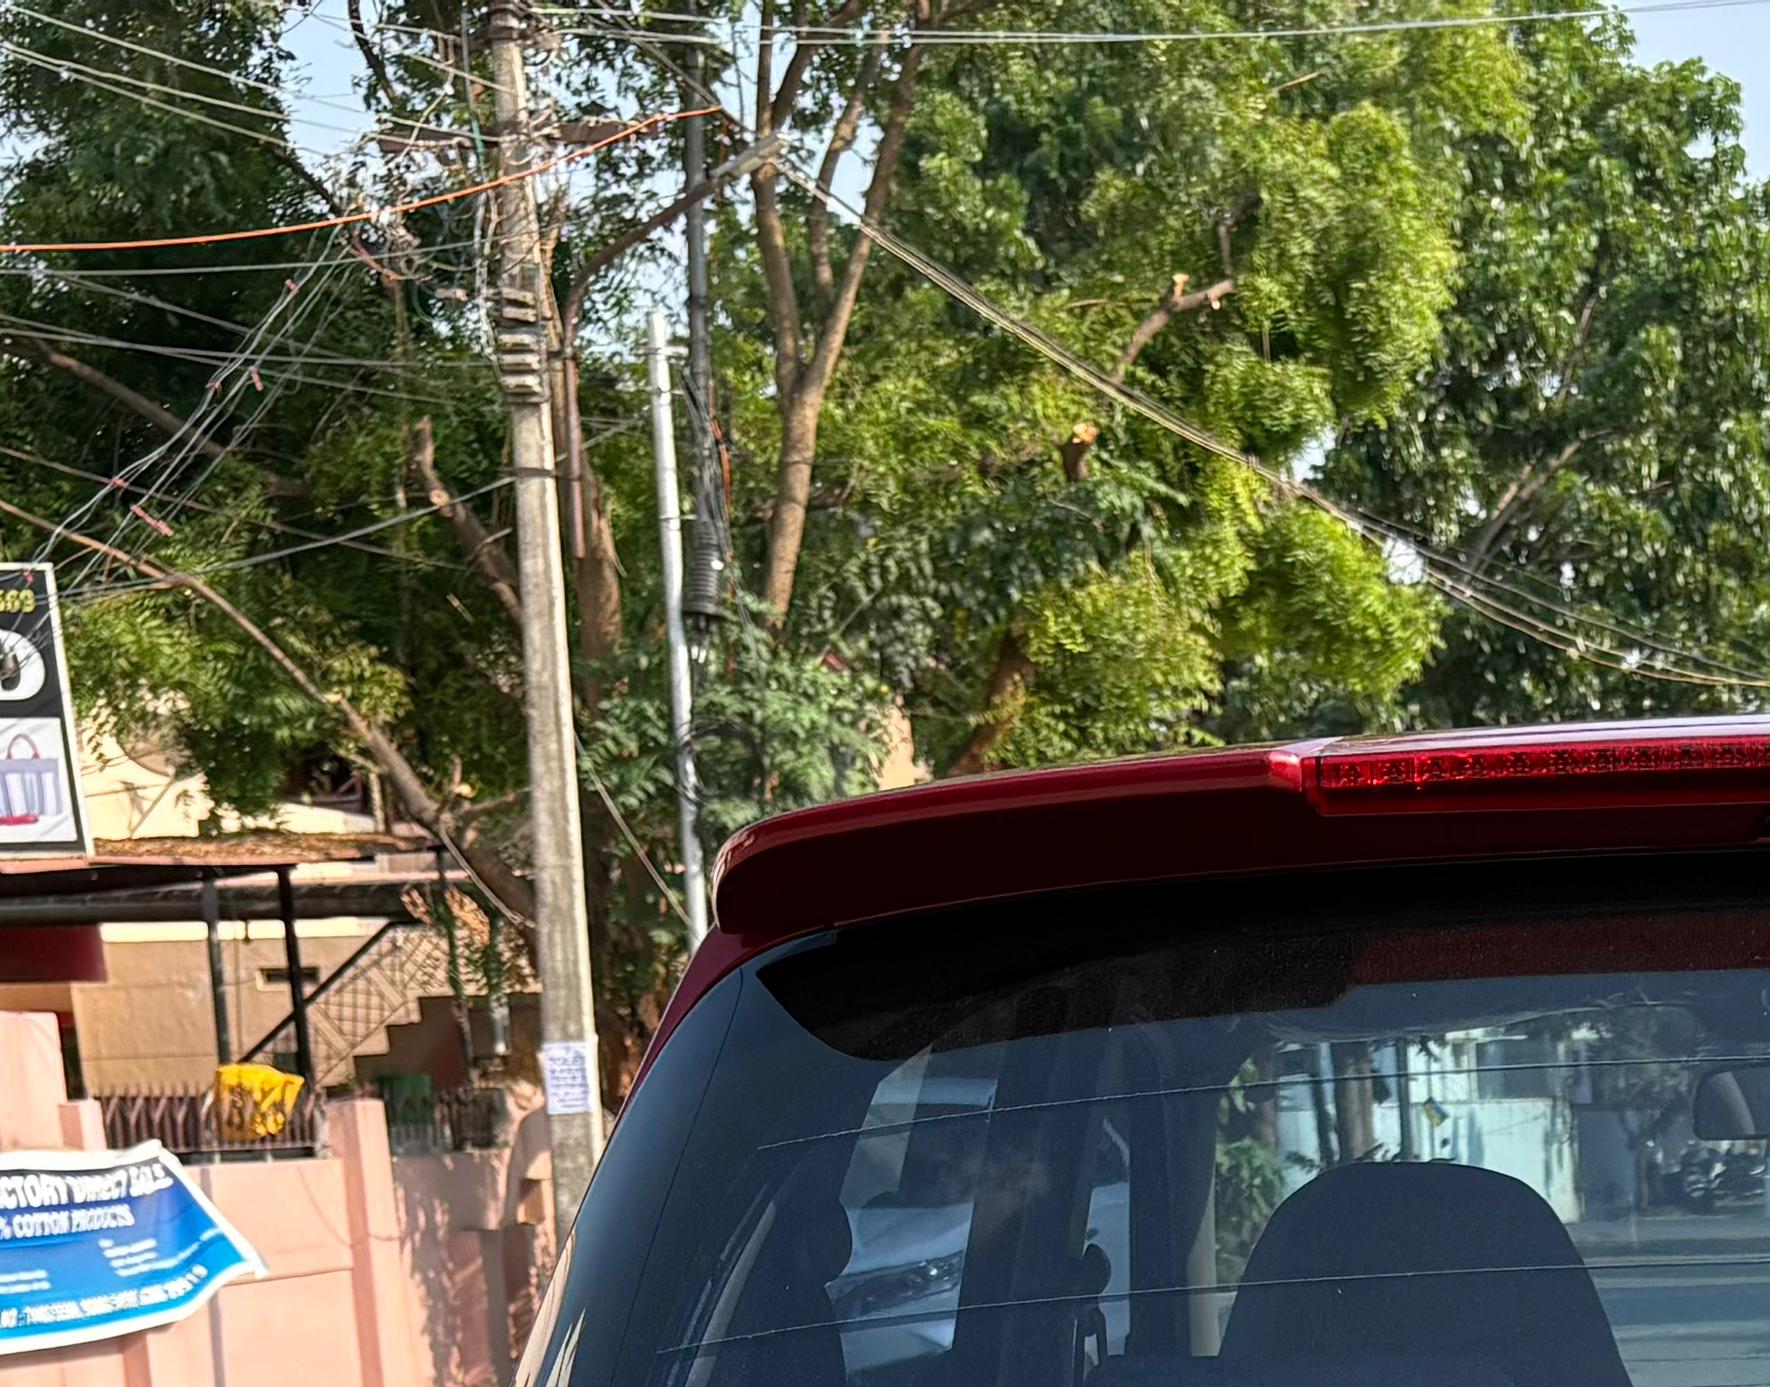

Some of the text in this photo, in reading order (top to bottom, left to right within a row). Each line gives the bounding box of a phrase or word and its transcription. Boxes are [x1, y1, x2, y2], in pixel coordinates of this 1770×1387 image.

[0, 1174, 70, 1210] CTORY
[12, 1210, 70, 1239] COTTON
[71, 1203, 136, 1232] PRODUCTS
